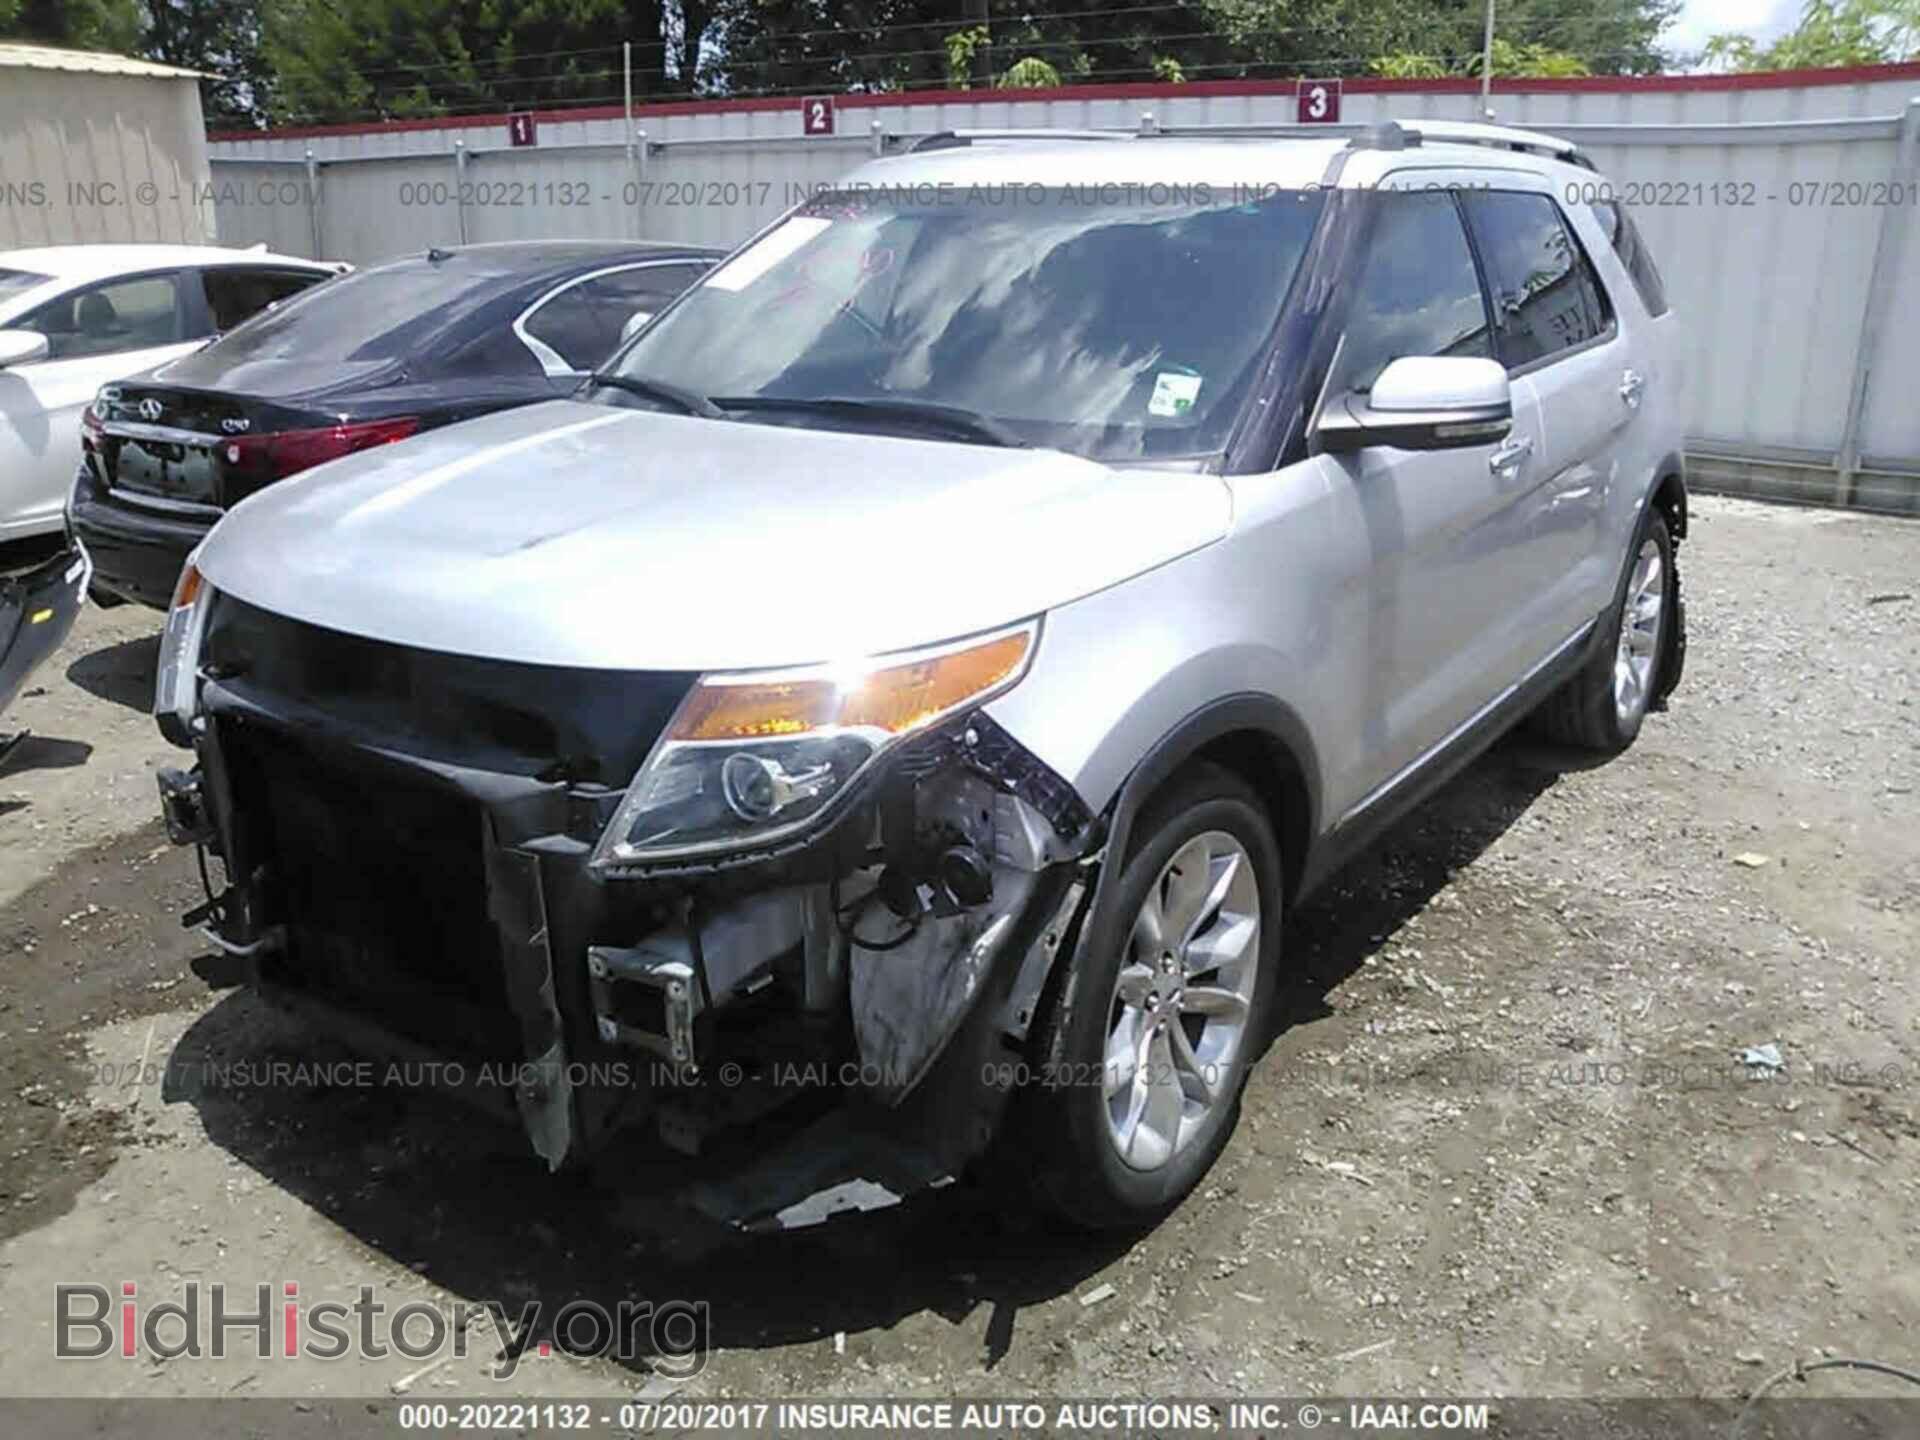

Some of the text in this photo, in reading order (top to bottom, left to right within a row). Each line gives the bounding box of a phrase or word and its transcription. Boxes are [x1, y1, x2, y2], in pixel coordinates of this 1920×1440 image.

[1309, 86, 1327, 118] 3
[812, 103, 825, 129] 2
[516, 119, 526, 141] 1
